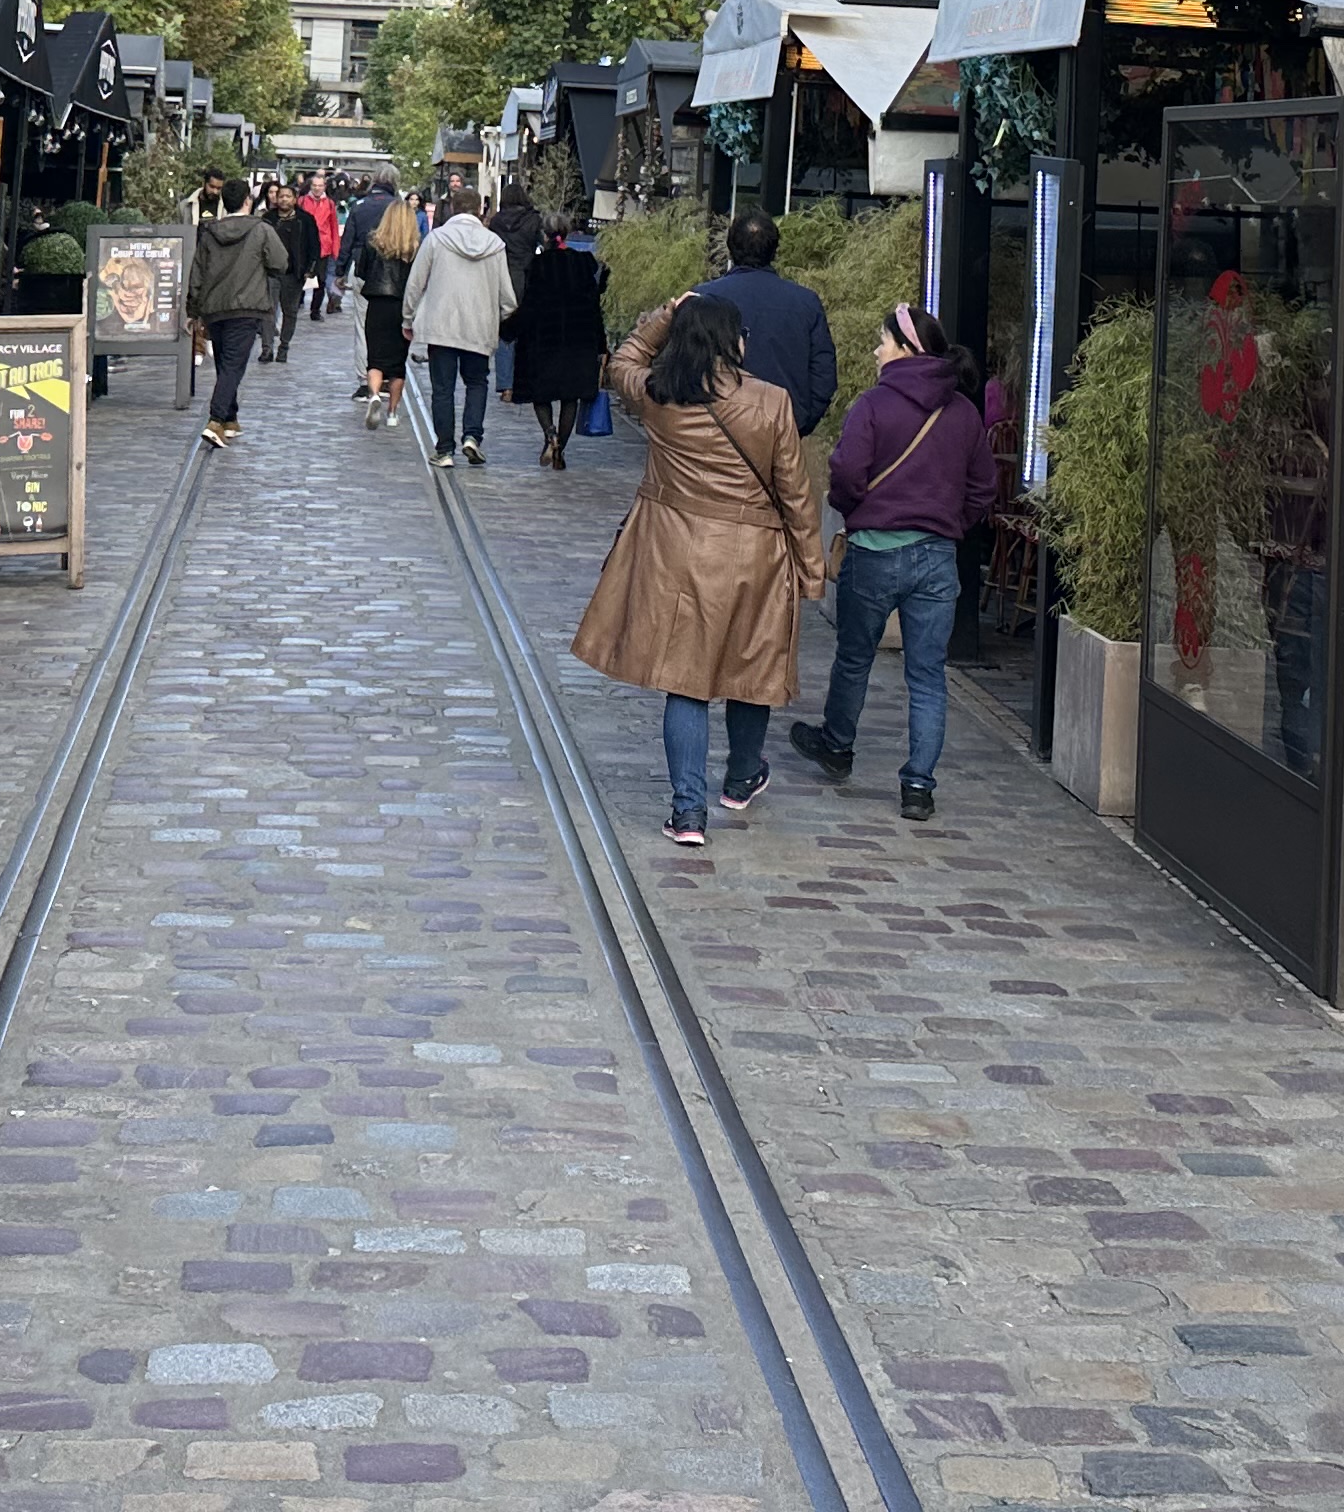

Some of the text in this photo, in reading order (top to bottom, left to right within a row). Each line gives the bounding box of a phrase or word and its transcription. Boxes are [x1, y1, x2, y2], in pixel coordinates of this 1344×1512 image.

[19, 343, 63, 354] VILLAGE
[8, 365, 28, 386] AU
[29, 358, 64, 383] FROG
[27, 404, 36, 418] 2
[25, 481, 41, 494] GIN
